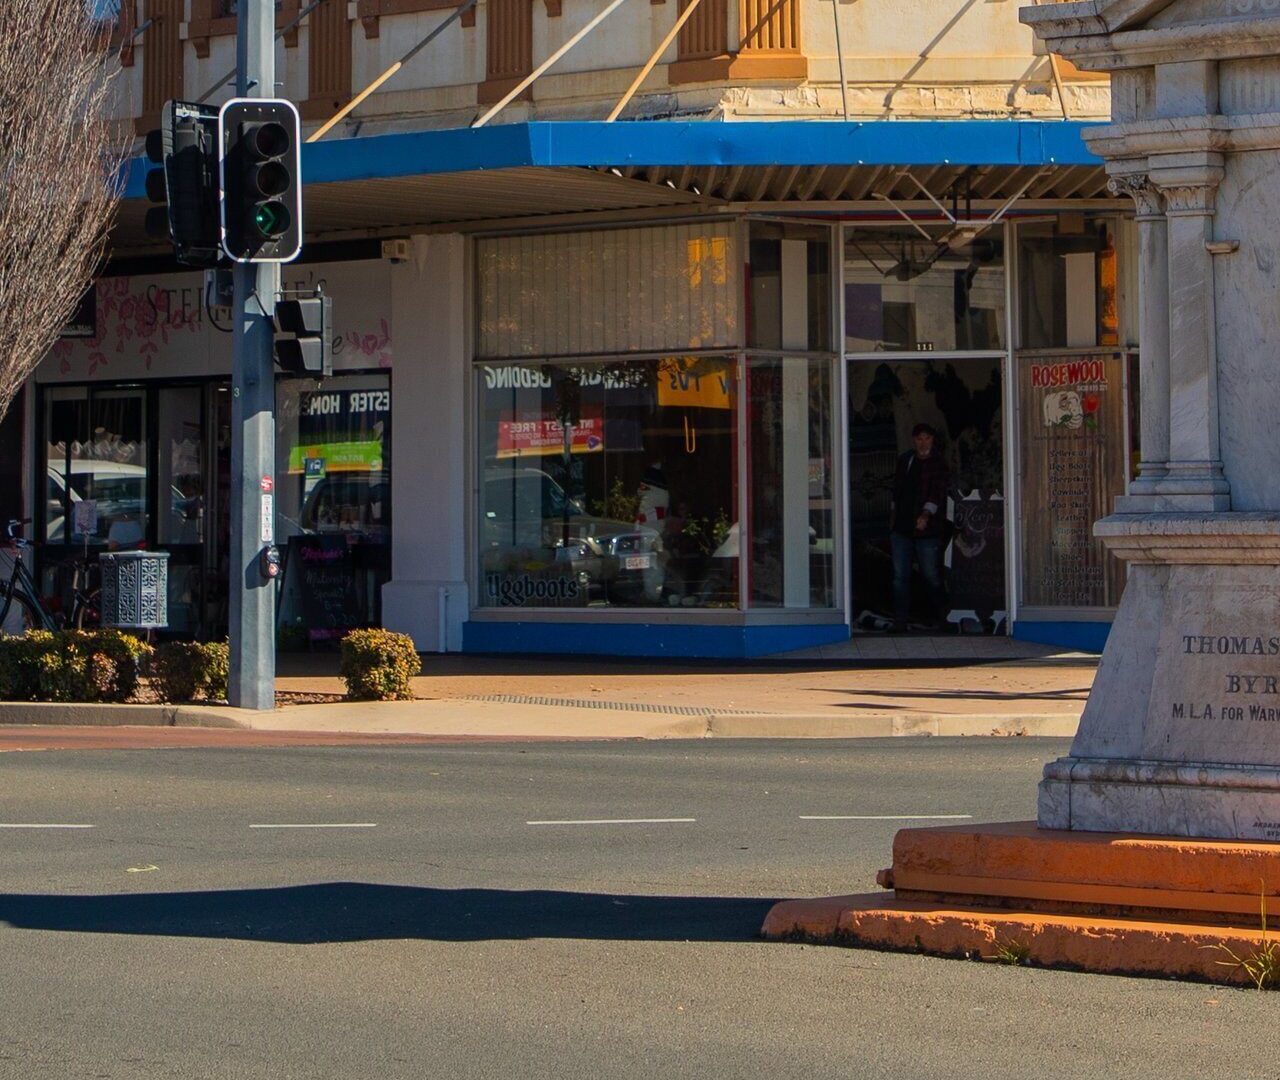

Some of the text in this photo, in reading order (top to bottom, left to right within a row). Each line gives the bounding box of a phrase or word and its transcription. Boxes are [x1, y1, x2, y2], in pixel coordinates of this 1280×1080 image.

[1031, 360, 1107, 388] ROSEWOOL
[488, 575, 578, 606] Uggboots
[1182, 635, 1280, 656] THOMAS
[1221, 706, 1244, 721] FOR
